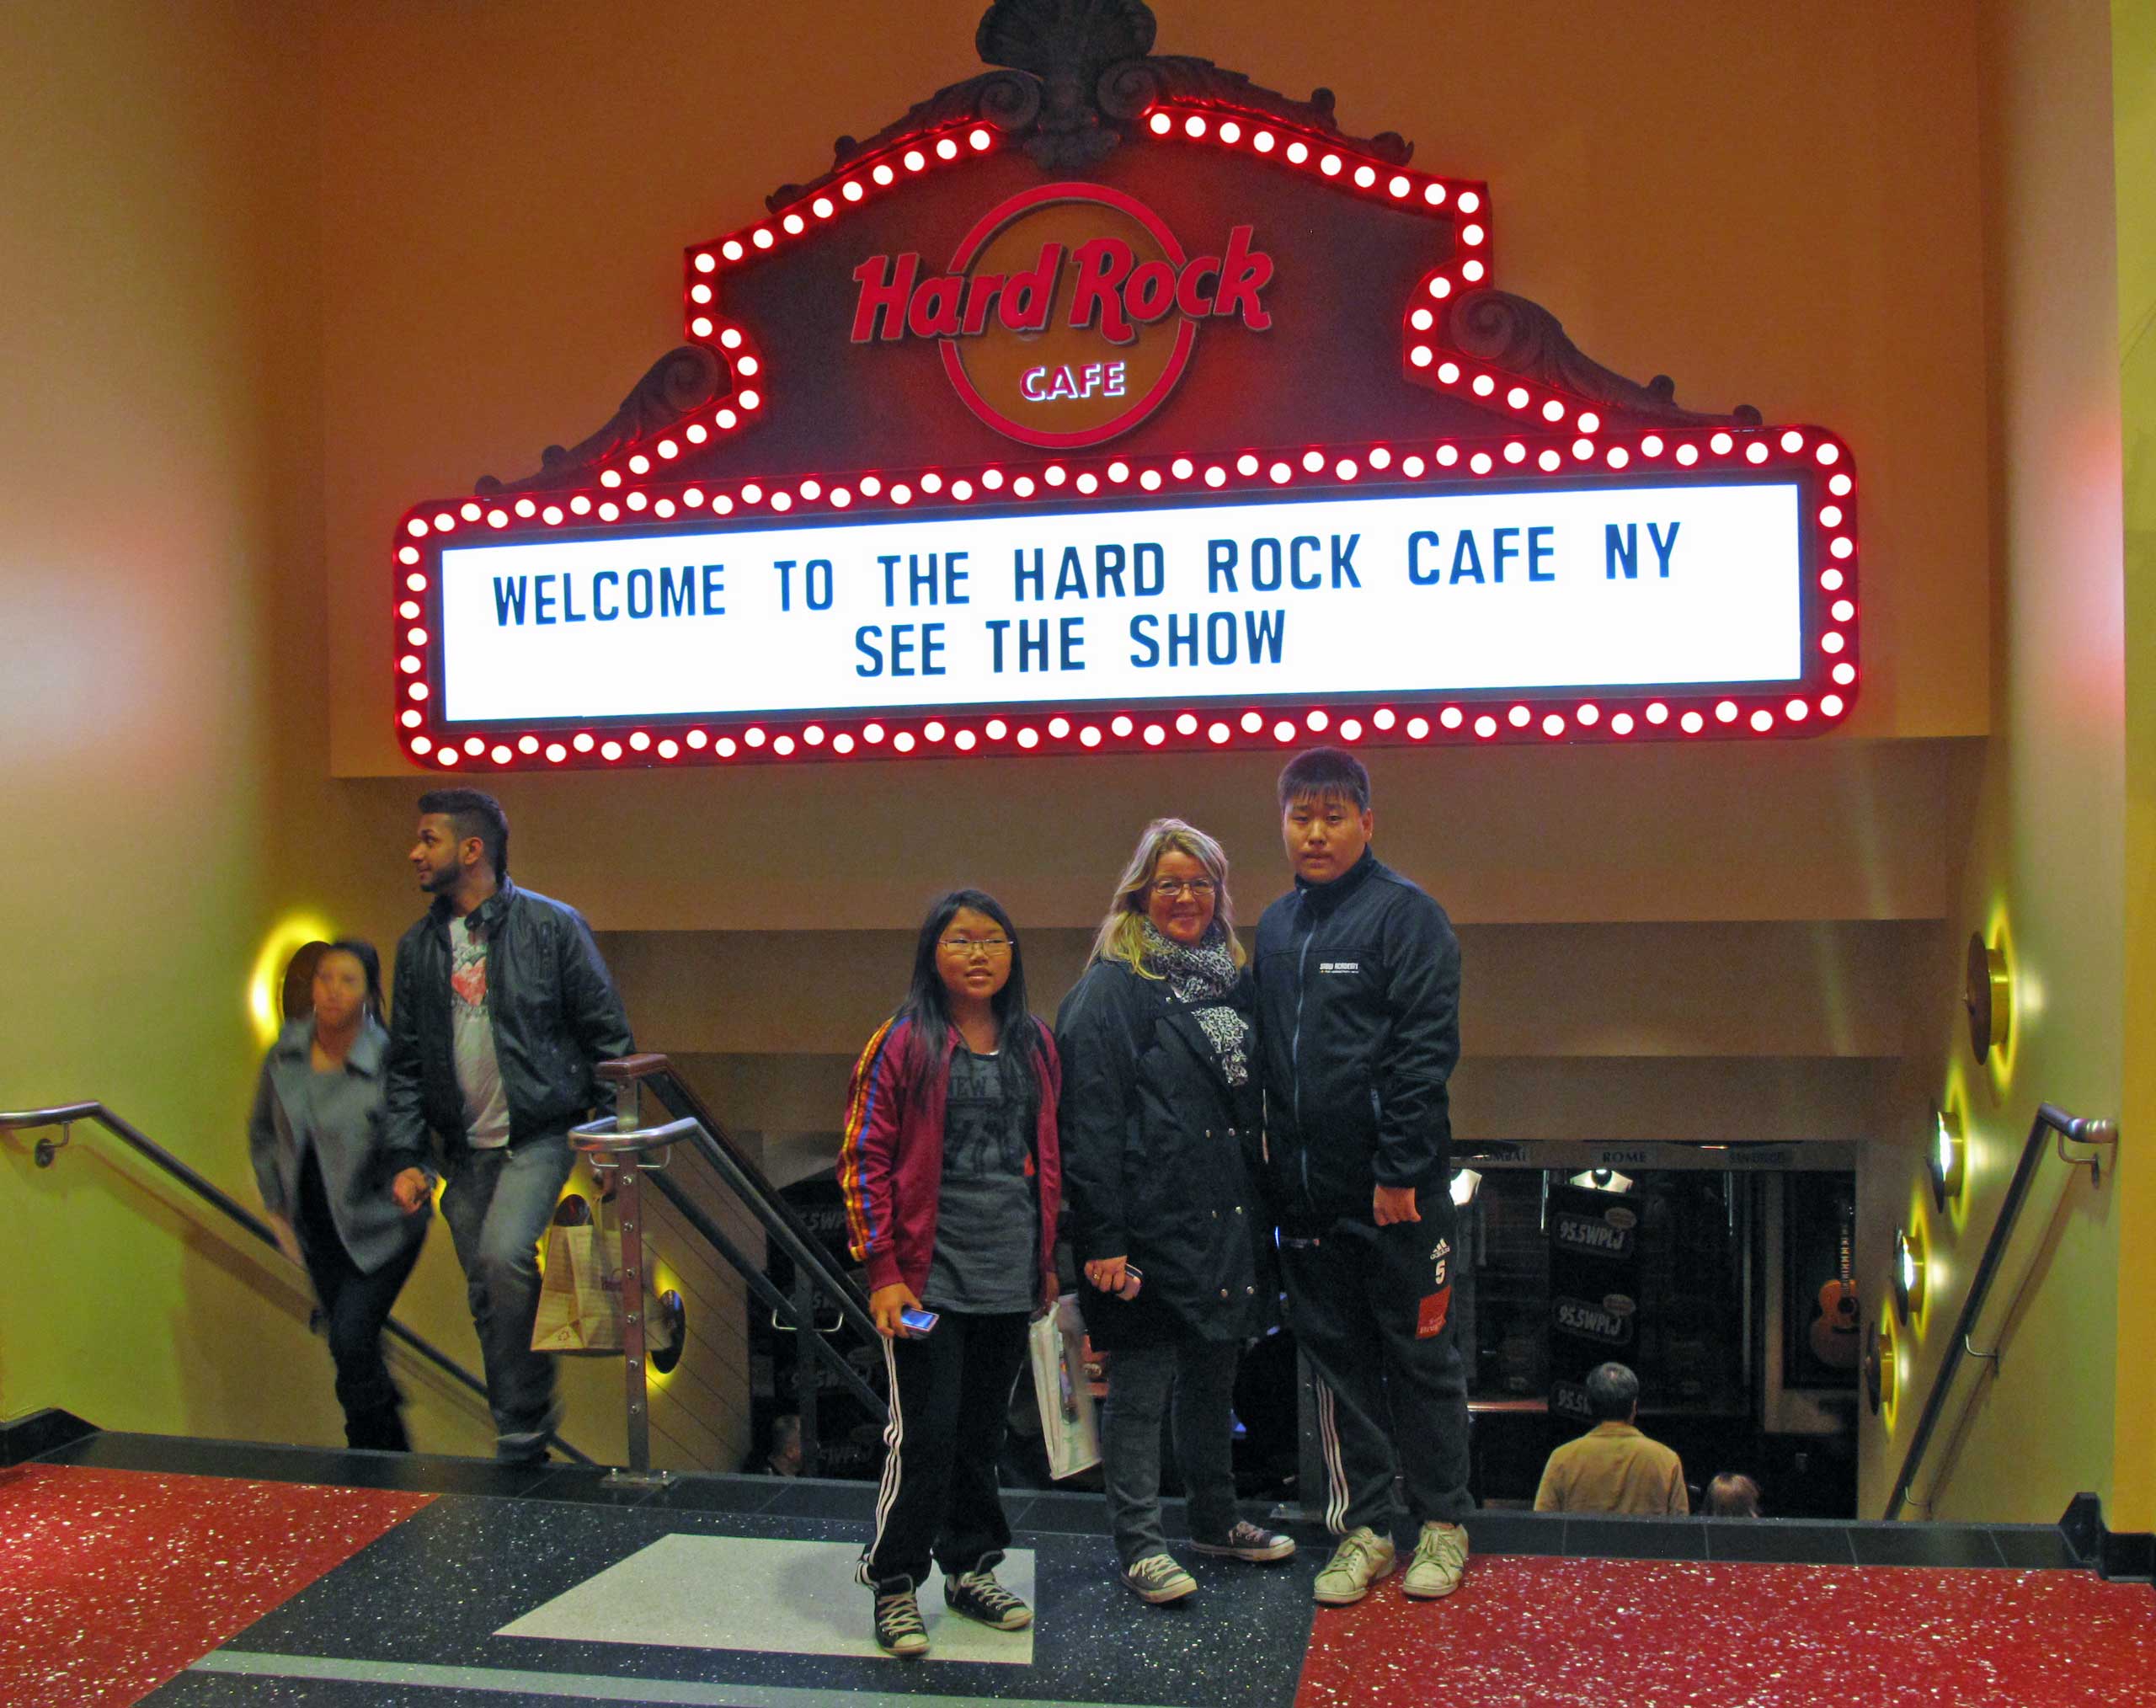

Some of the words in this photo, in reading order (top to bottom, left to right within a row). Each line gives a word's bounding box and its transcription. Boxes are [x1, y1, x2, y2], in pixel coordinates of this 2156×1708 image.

[850, 241, 1062, 344] Hard
[1066, 224, 1274, 345] Rock
[1019, 360, 1126, 401] CAFE
[493, 564, 725, 627] WELCOME
[773, 558, 833, 611] TO
[877, 552, 970, 607] THE
[1014, 542, 1165, 602] HARD
[1208, 533, 1362, 594] ROCK
[1407, 526, 1556, 585] CAFE
[1605, 521, 1681, 579] NY
[855, 622, 946, 678] SEE
[985, 616, 1086, 674] THE
[1129, 609, 1285, 668] SHOW
[1602, 1151, 1646, 1163] ROME
[1435, 1260, 1445, 1285] 5
